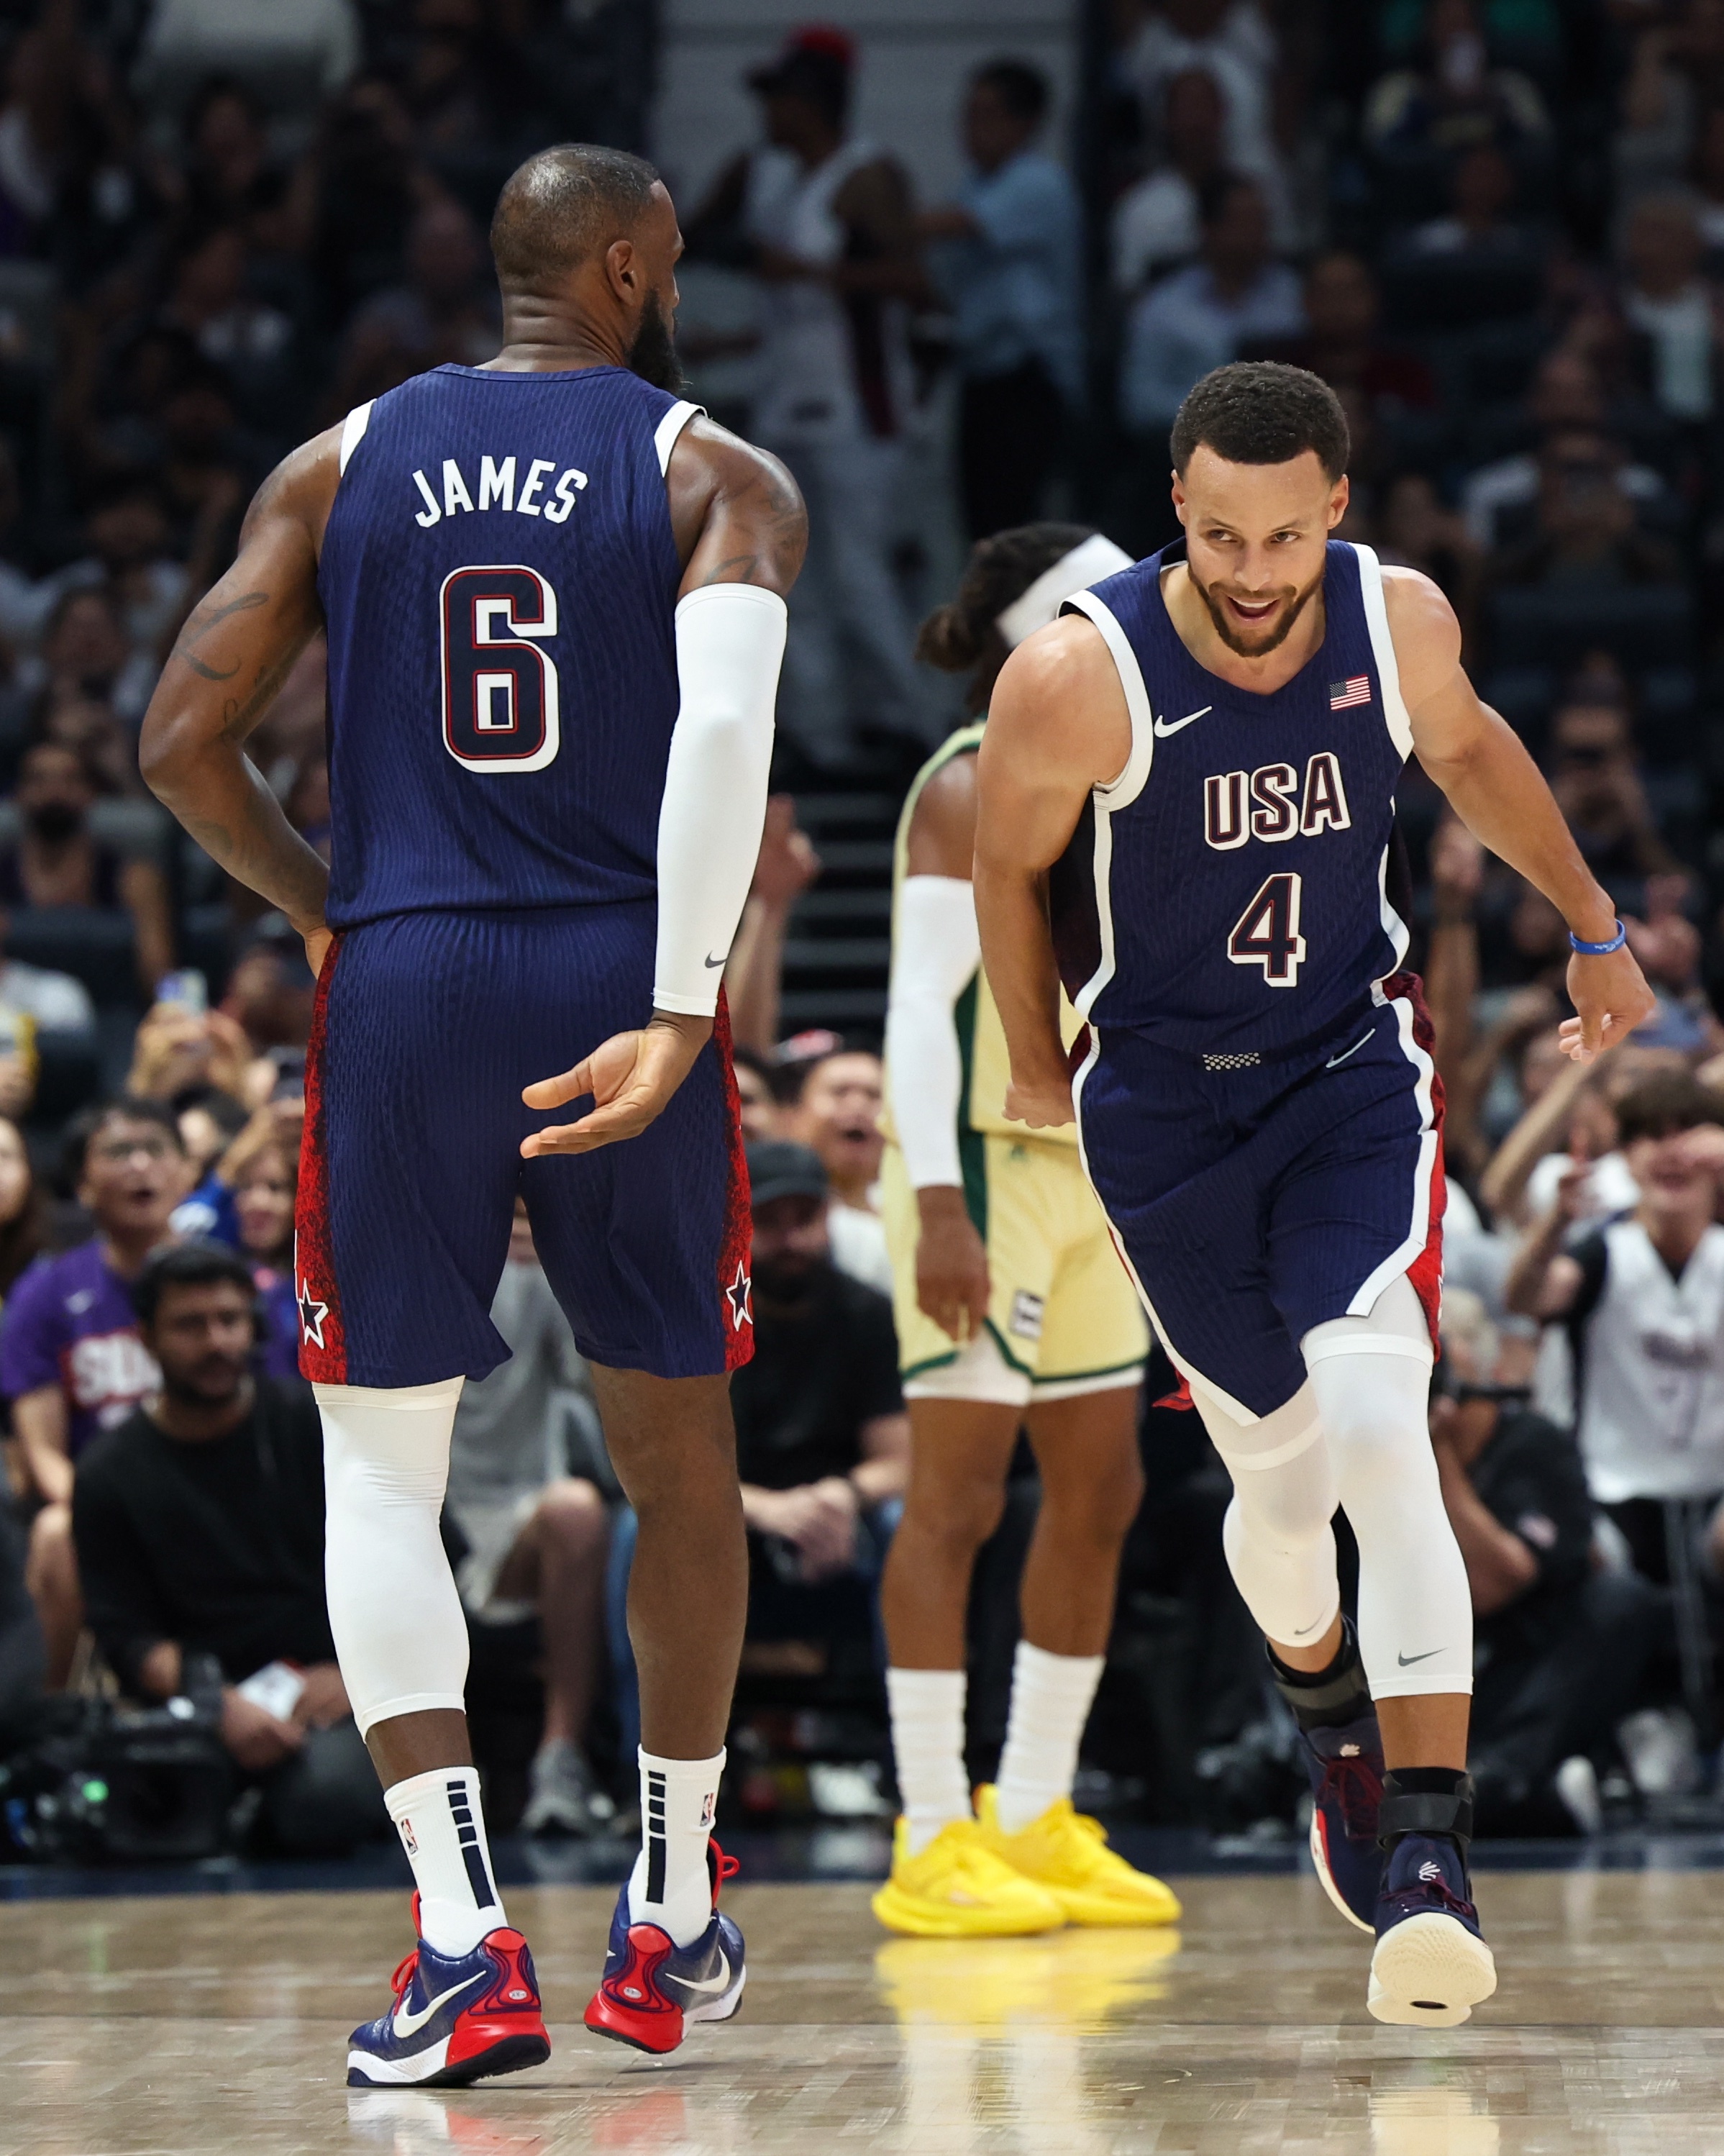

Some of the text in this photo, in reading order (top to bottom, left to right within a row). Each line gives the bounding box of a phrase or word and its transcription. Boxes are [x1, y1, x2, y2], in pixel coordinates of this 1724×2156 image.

[412, 455, 588, 528] JAMES
[439, 564, 560, 774] 6
[1204, 752, 1351, 850] USA
[1227, 872, 1307, 988] 4
